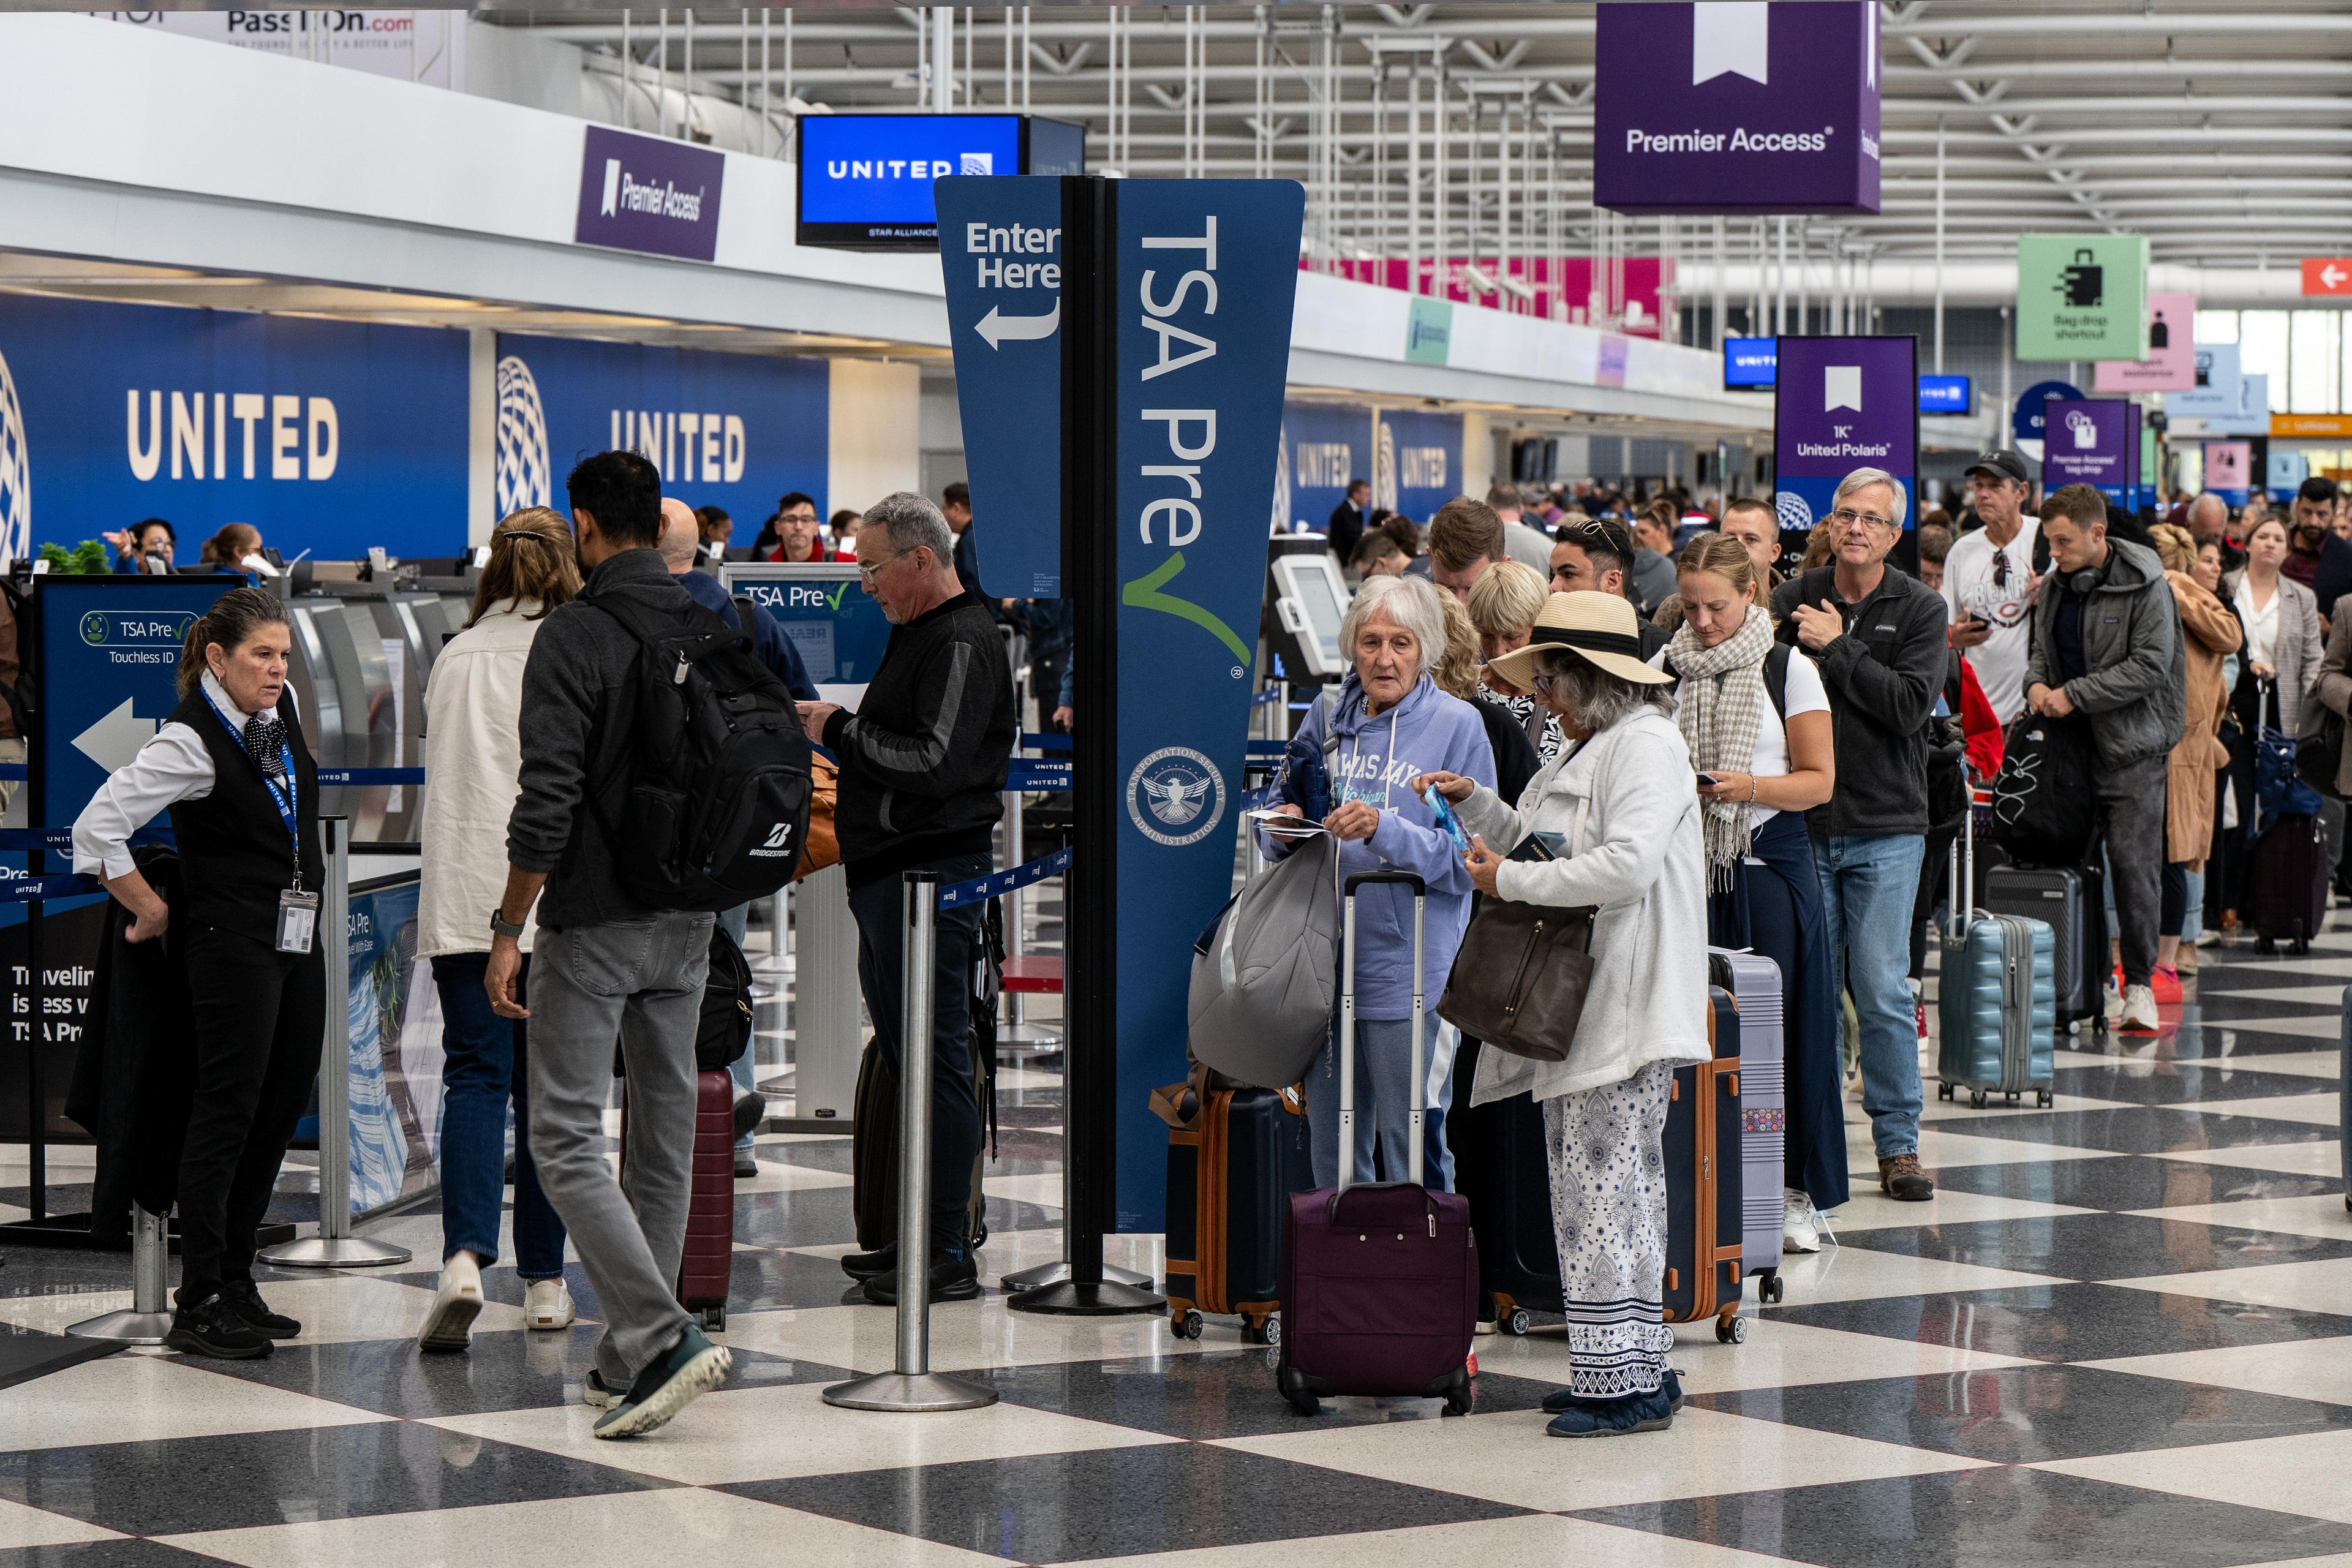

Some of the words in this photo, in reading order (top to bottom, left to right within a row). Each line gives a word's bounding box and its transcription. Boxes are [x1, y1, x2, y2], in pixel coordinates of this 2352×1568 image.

[228, 10, 414, 32] PassIOn.com
[1626, 128, 1726, 153] Premier
[827, 160, 952, 179] UNITED
[620, 172, 665, 215] Premier
[869, 228, 893, 238] STAR
[894, 228, 939, 238] ALLIANCE
[967, 222, 1061, 254] Enter
[978, 257, 1061, 288] Here
[1139, 215, 1218, 383] TSA
[127, 389, 339, 481] UNITED
[611, 409, 745, 482] UNITED
[1797, 442, 1841, 457] United
[1139, 409, 1217, 547] Pre
[1296, 443, 1351, 488] UNITED
[1401, 447, 1447, 488] UNITED
[744, 586, 785, 607] TSA
[790, 586, 824, 607] Pre
[1973, 576, 2029, 608] BEAR
[120, 622, 146, 637] TSA
[149, 622, 172, 637] Pre
[109, 651, 160, 663] Touchless
[162, 652, 174, 663] ID
[1128, 748, 1197, 803] TRANSPORTATION
[1198, 756, 1224, 803] SECURITY
[265, 778, 284, 807] UNITED
[1133, 816, 1218, 845] ADMINISTRATION
[748, 848, 791, 858] BRIDGESTONE
[1531, 843, 1550, 862] PASSPO
[347, 914, 356, 937] SA
[357, 913, 369, 935] Pre
[56, 1022, 83, 1042] Pr
